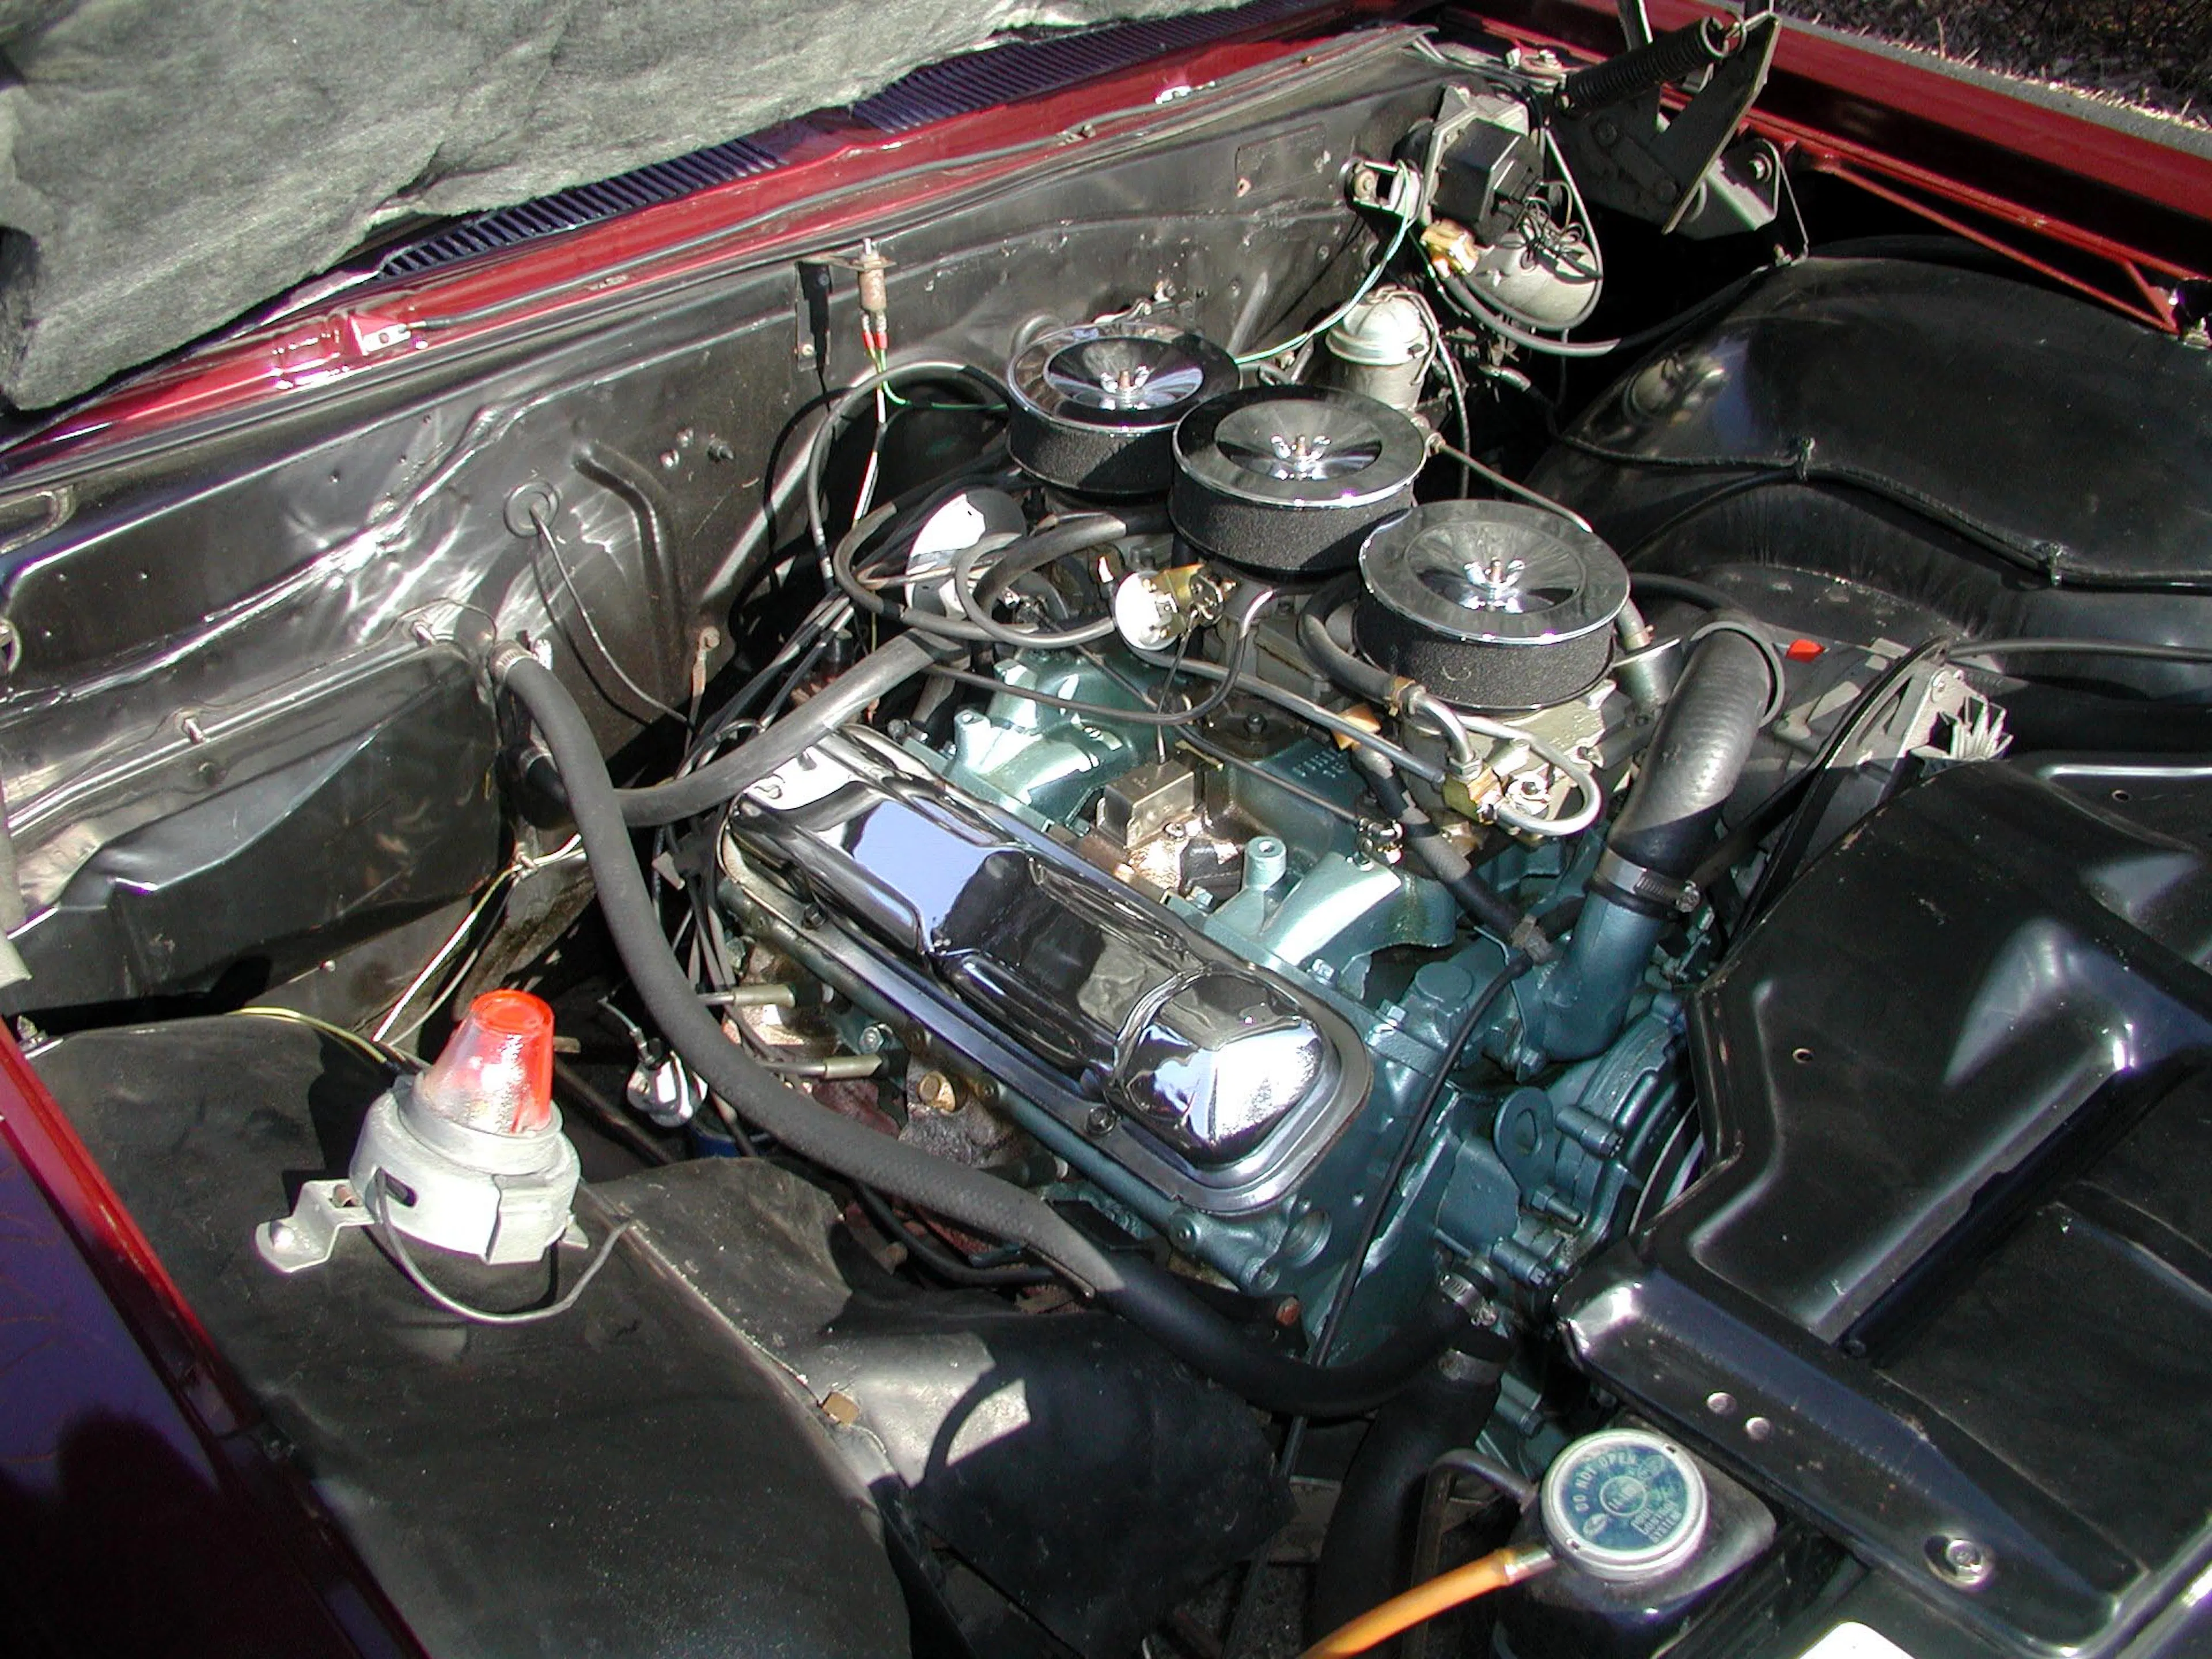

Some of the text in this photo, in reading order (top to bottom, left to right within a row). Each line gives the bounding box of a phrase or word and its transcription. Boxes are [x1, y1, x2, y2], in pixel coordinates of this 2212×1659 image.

[1597, 1450, 1638, 1468] OPEN
[1575, 1465, 1597, 1490] NOT
[1573, 1494, 1590, 1513] DO
